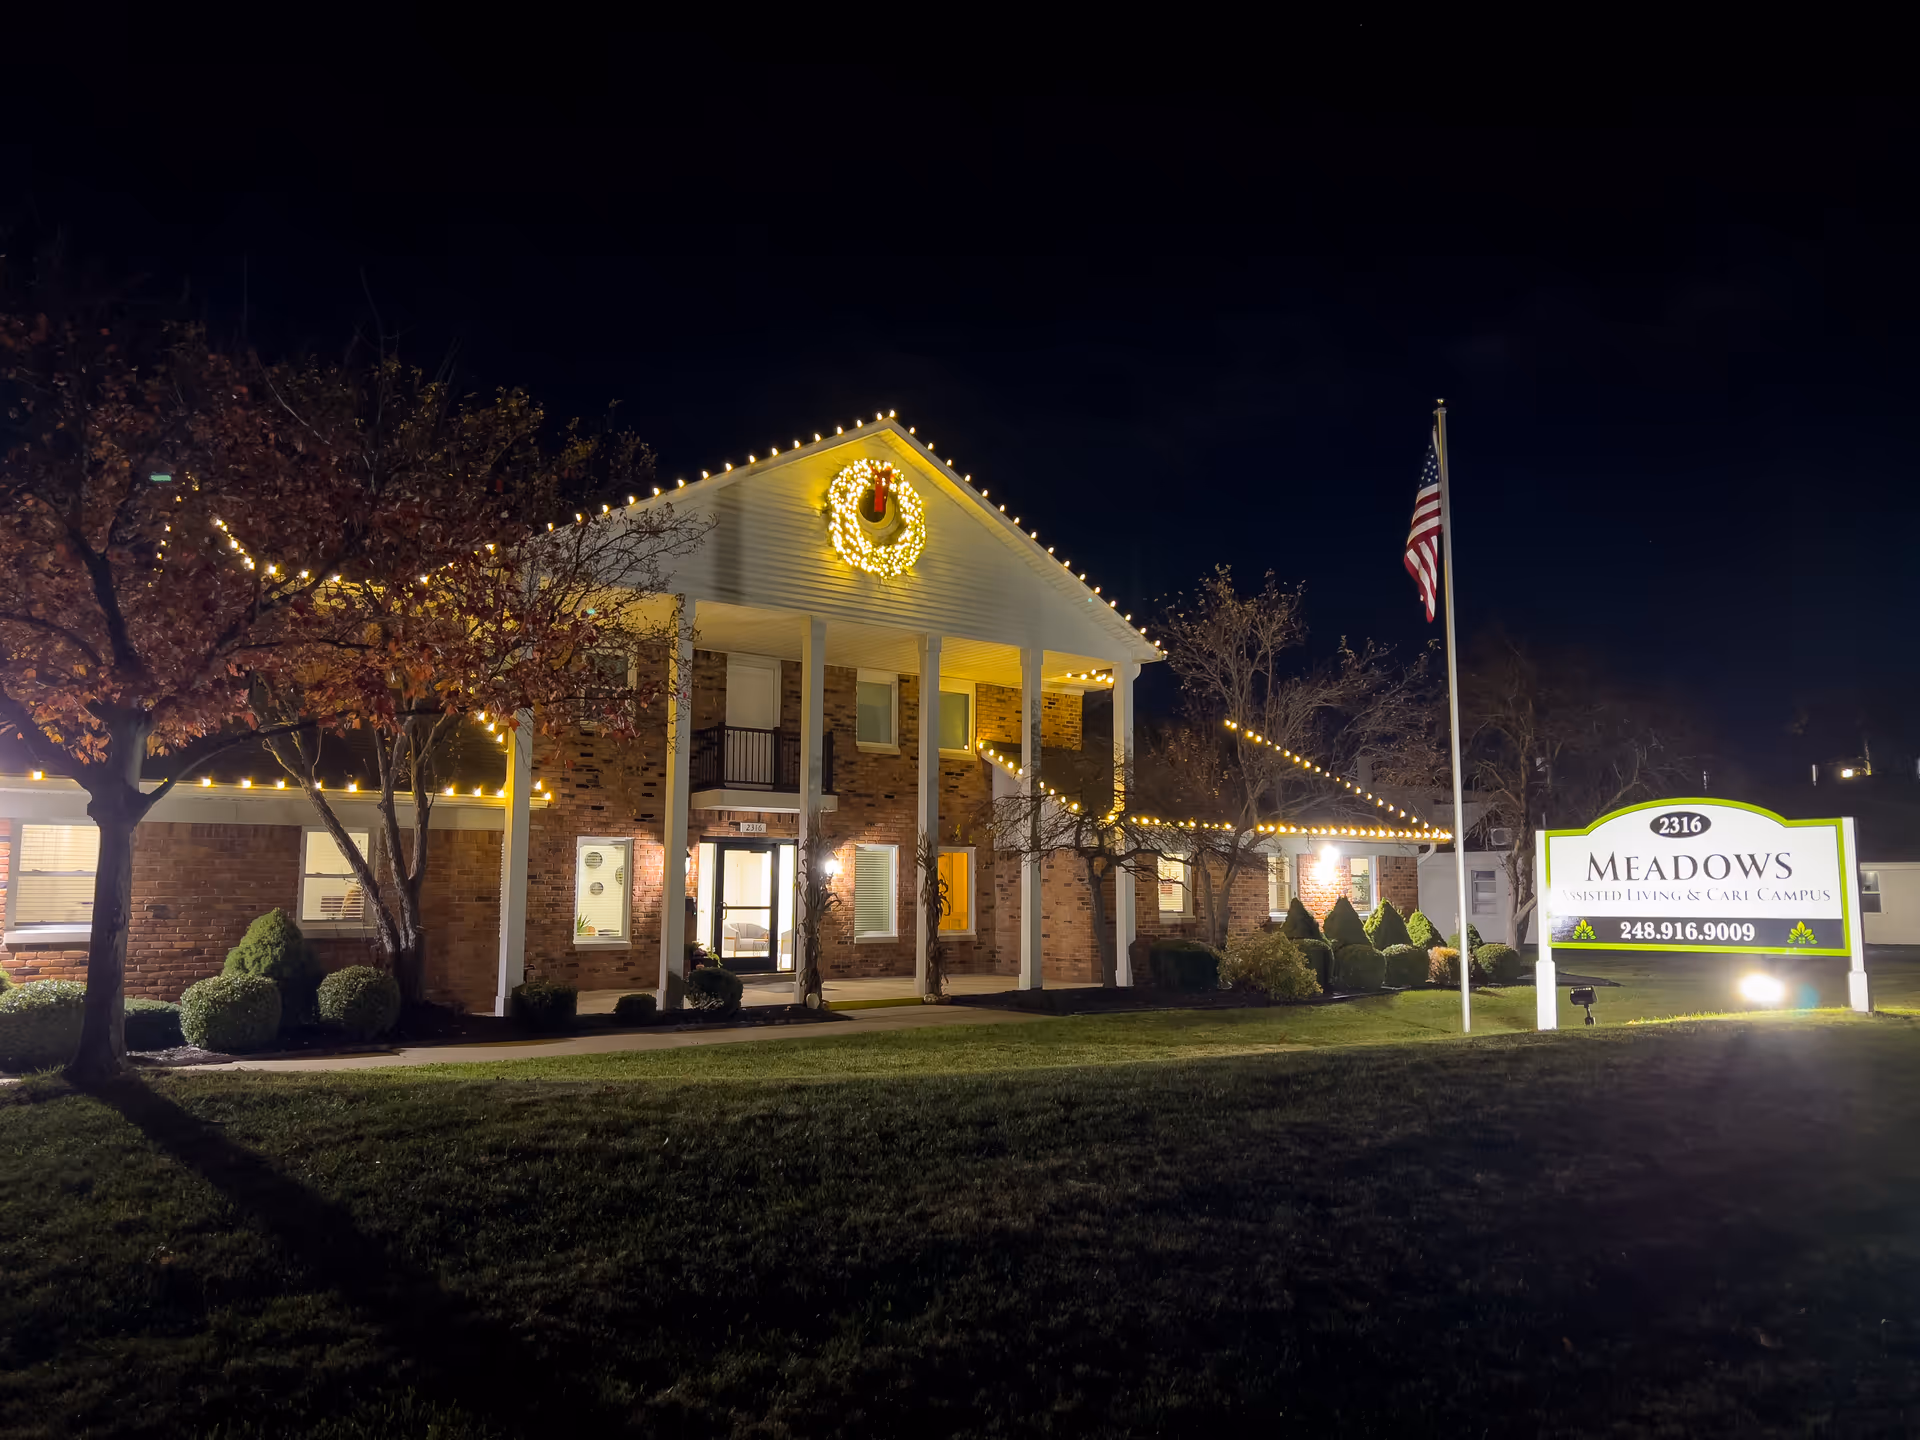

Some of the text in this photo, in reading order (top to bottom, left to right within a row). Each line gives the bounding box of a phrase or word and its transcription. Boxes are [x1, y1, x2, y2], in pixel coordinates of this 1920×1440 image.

[745, 824, 763, 832] 2316
[1659, 817, 1702, 834] 2316
[1585, 851, 1793, 881] MEADOWS
[1687, 888, 1701, 901] &
[1757, 887, 1831, 901] CAMPUS
[1620, 922, 1755, 941] 248.916.9009
